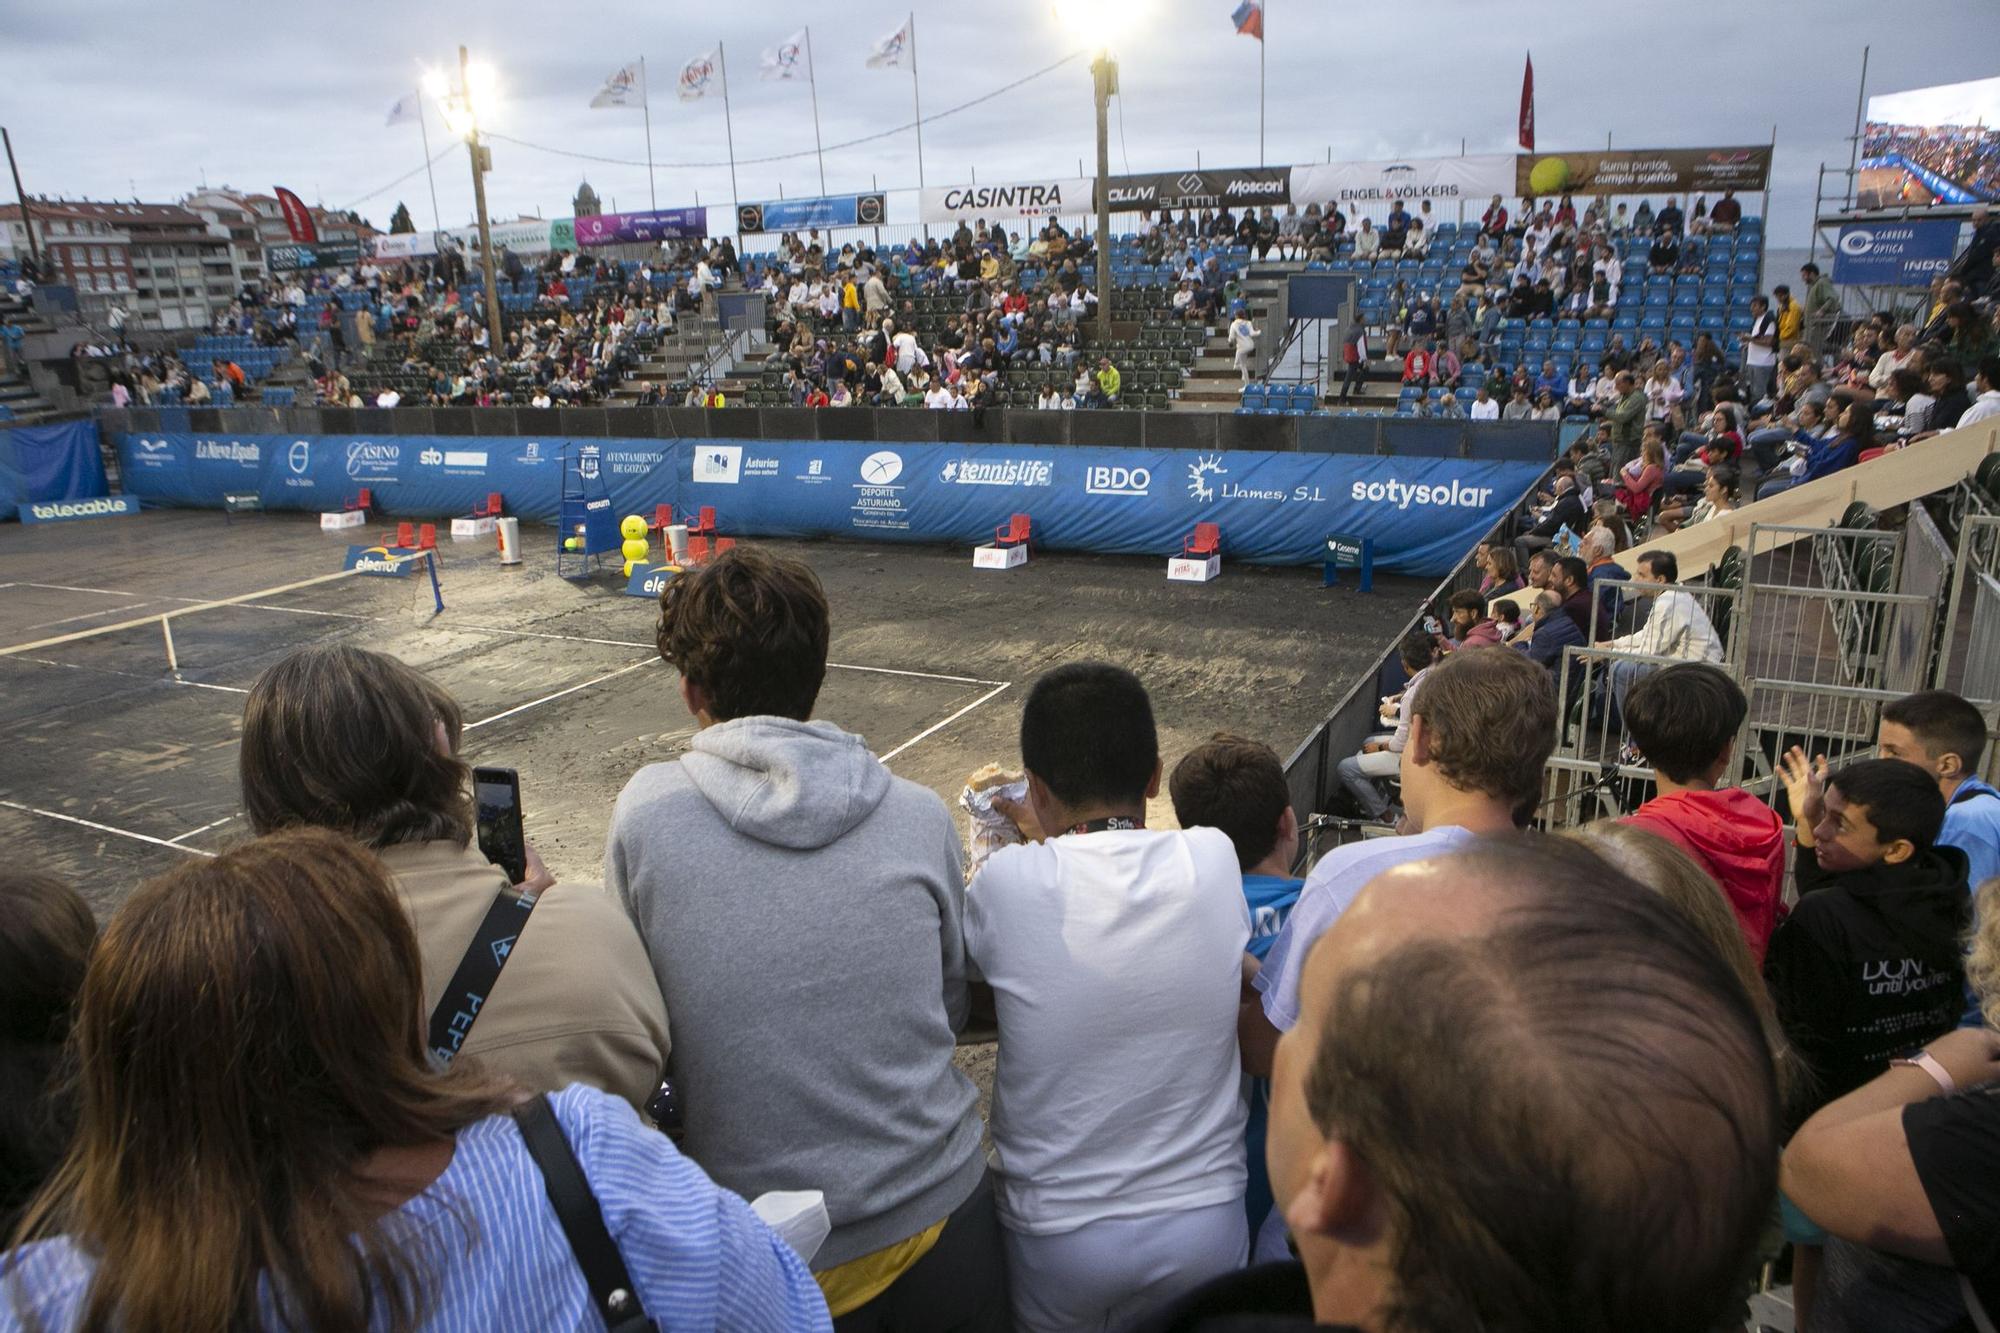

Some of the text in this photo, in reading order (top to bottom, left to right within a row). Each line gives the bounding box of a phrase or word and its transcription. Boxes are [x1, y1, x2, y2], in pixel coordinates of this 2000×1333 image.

[1600, 160, 1629, 172] Suma
[1595, 173, 1634, 186] cumple
[1637, 172, 1678, 184] sueños
[944, 184, 1062, 210] CASINTRA
[1159, 194, 1220, 209] SUMMIT
[1226, 179, 1284, 197] Mosconi
[1341, 185, 1459, 201] ENGEL&VÖLKERS
[1875, 230, 1913, 242] CARRERA
[1872, 242, 1904, 255] ÓPTICA
[196, 440, 260, 463] La Nueva España
[346, 442, 400, 475] CASINO
[420, 447, 443, 465] sto
[606, 451, 663, 463] AYUNTAMIENTO
[613, 463, 651, 473] DE GOZÓN
[745, 457, 779, 469] Asturias
[959, 460, 1050, 486] tennislife
[1094, 467, 1151, 490] BDO
[861, 488, 895, 497] DEPORTE
[1221, 483, 1327, 503] Llames, S.L
[1352, 478, 1493, 510] sotysolar
[32, 498, 127, 519] telecable
[857, 498, 901, 508] ASTURIANO
[1869, 974, 1903, 995] until
